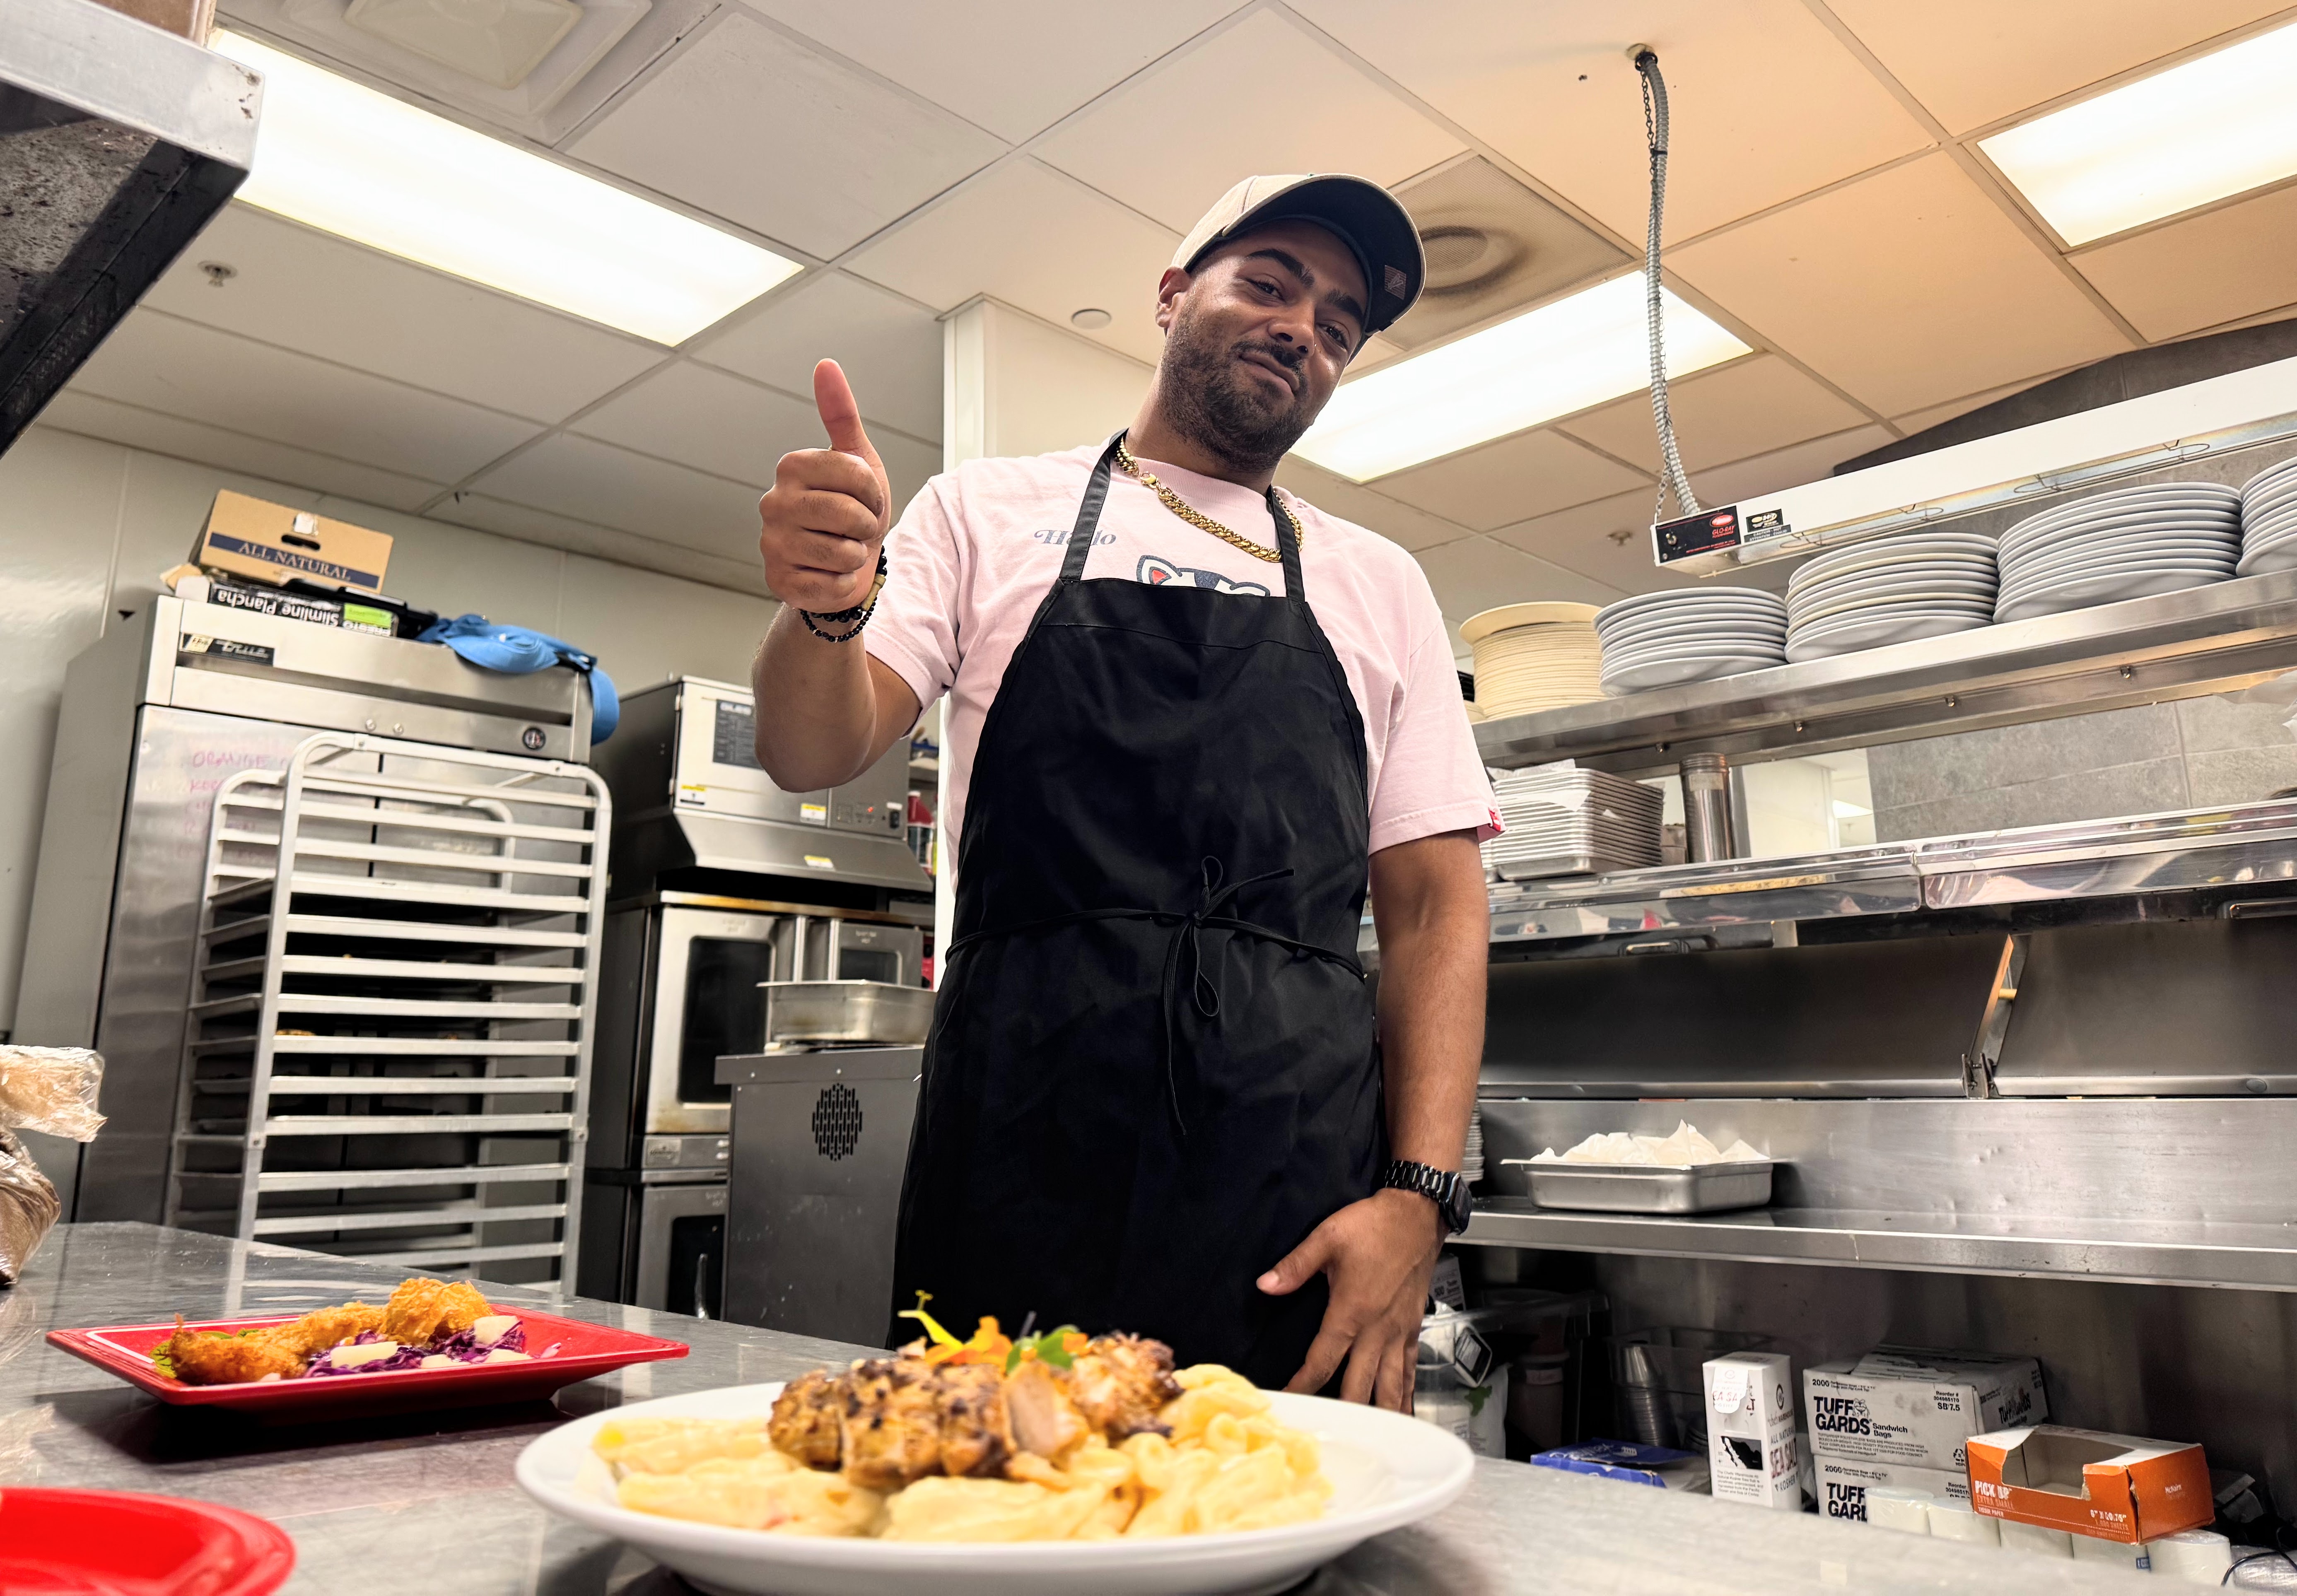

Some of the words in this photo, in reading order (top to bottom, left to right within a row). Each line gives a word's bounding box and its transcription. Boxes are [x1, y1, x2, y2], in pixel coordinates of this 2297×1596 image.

[1034, 529, 1117, 546] Hlo
[238, 543, 271, 560] ALL
[274, 551, 351, 581] NATURAL
[217, 588, 277, 615] Plancha
[281, 603, 339, 627] Slimline
[1812, 1379, 1829, 1387] 2000
[1814, 1396, 1854, 1415] TUFF
[1815, 1413, 1870, 1435] GARDS
[1872, 1423, 1908, 1433] Sandwich
[1874, 1430, 1892, 1439] Bags
[1825, 1464, 1842, 1473] 2000
[1827, 1482, 1865, 1504] TUFF
[1974, 1480, 1995, 1497] PICK
[1828, 1500, 1868, 1522] GAR
[1976, 1494, 1995, 1506] EXTRA
[1995, 1498, 2015, 1510] SMALL
